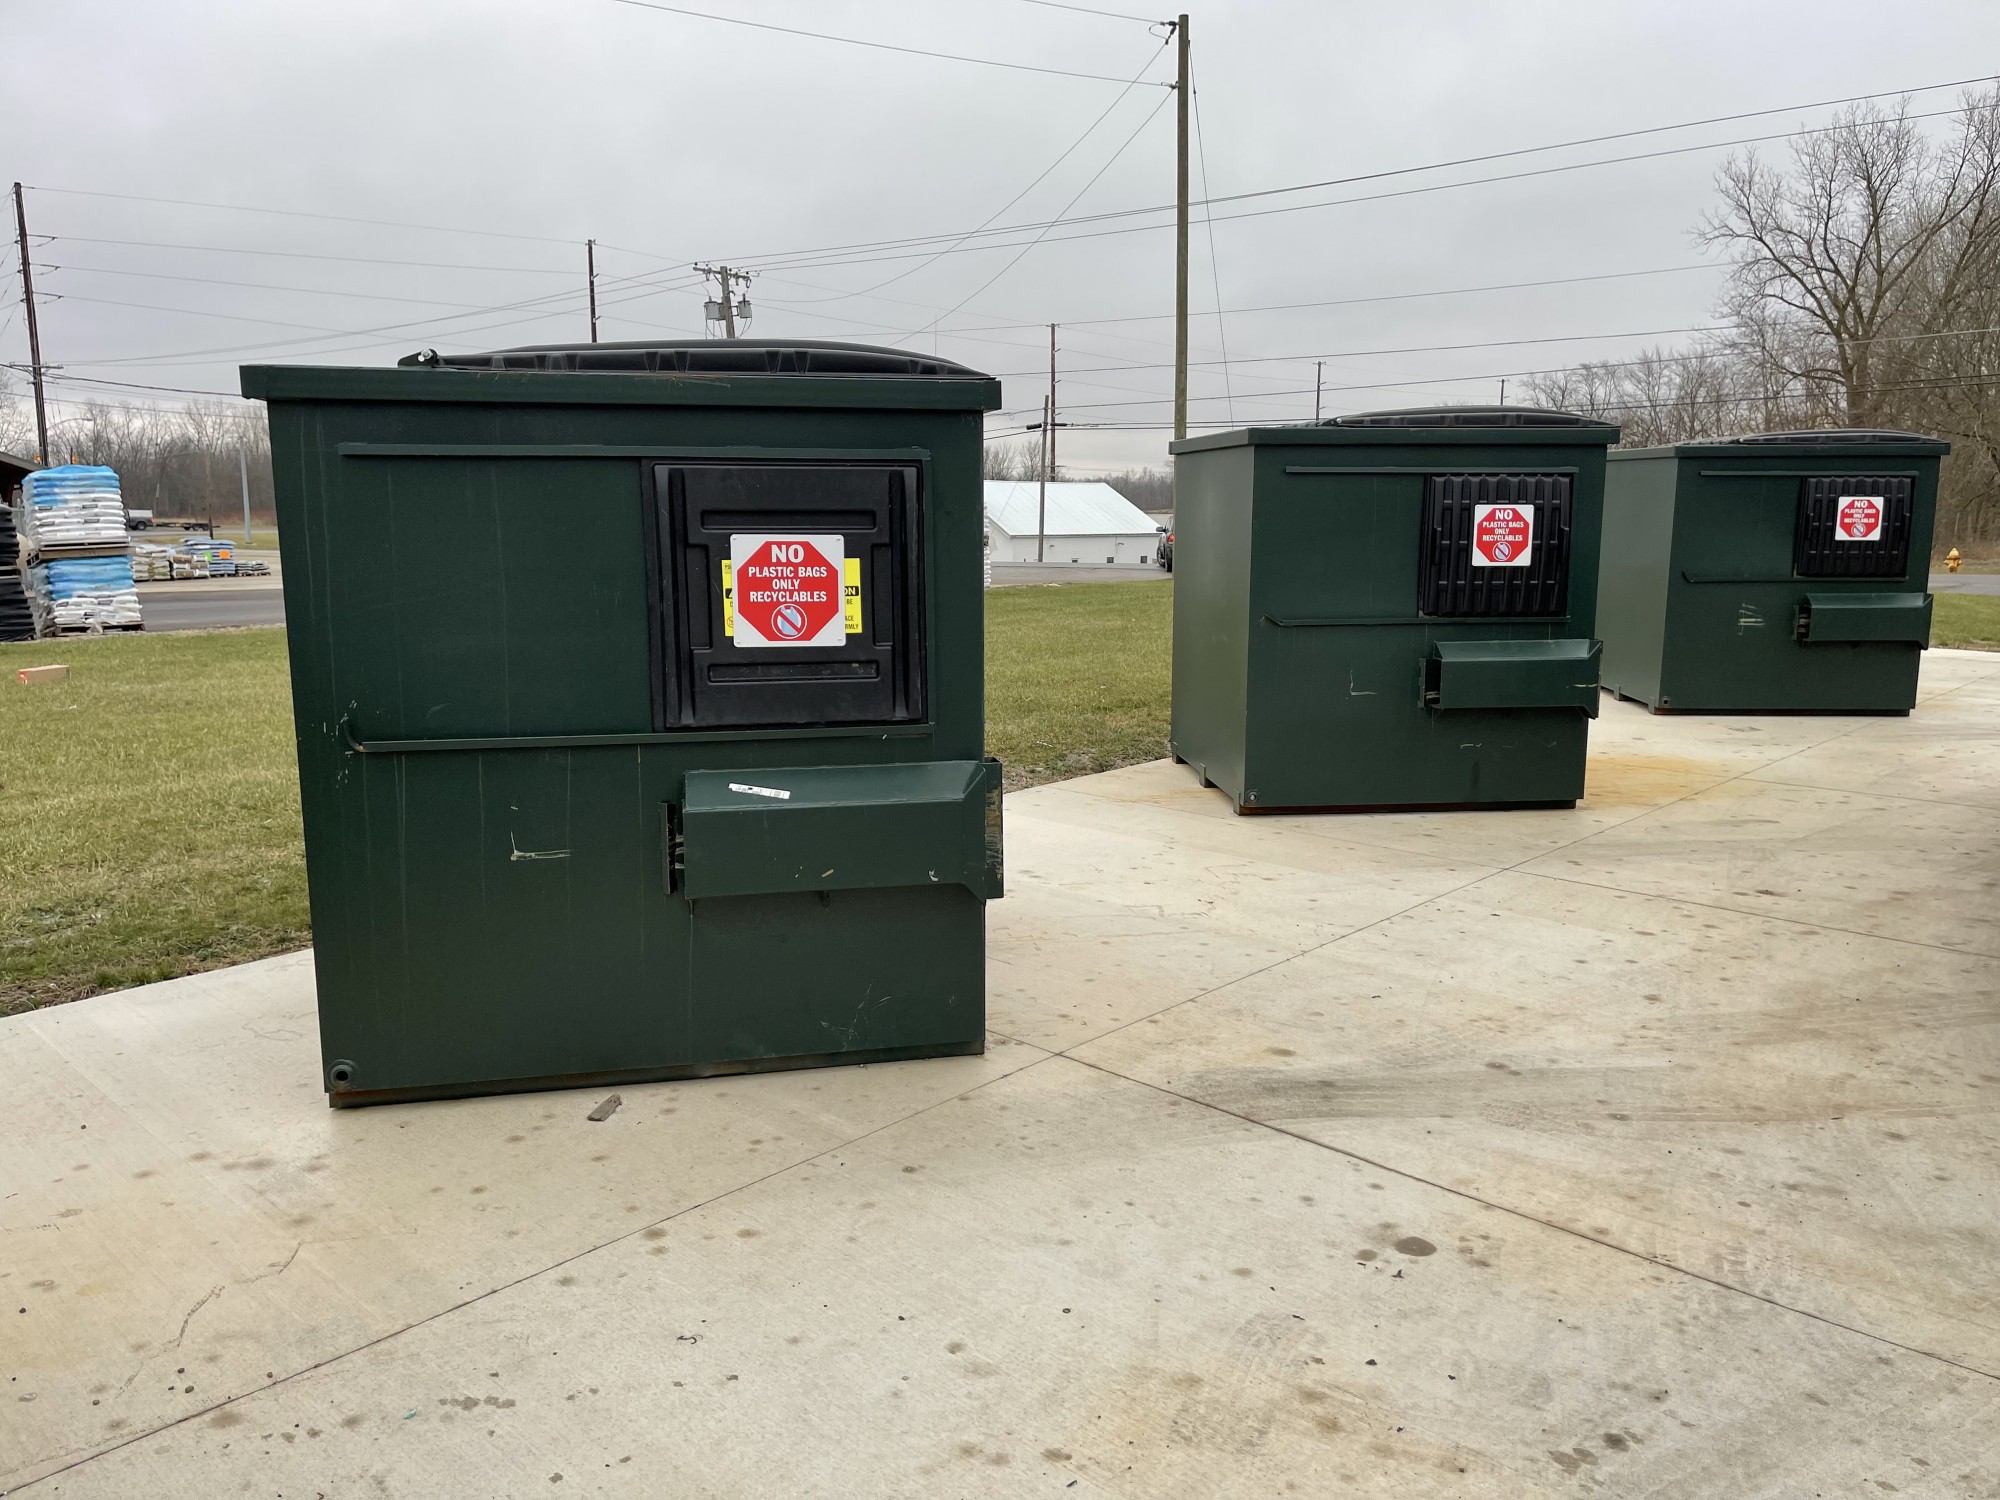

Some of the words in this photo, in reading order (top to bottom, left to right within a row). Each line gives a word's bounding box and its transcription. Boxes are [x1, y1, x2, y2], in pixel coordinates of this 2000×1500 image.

[1854, 500, 1868, 508] NO
[1495, 509, 1513, 520] NO
[771, 544, 804, 563] NO
[748, 566, 794, 578] PLASTIC
[798, 566, 827, 578] BAGS
[772, 579, 800, 590] ONLY
[750, 591, 827, 602] RECYCLABLES
